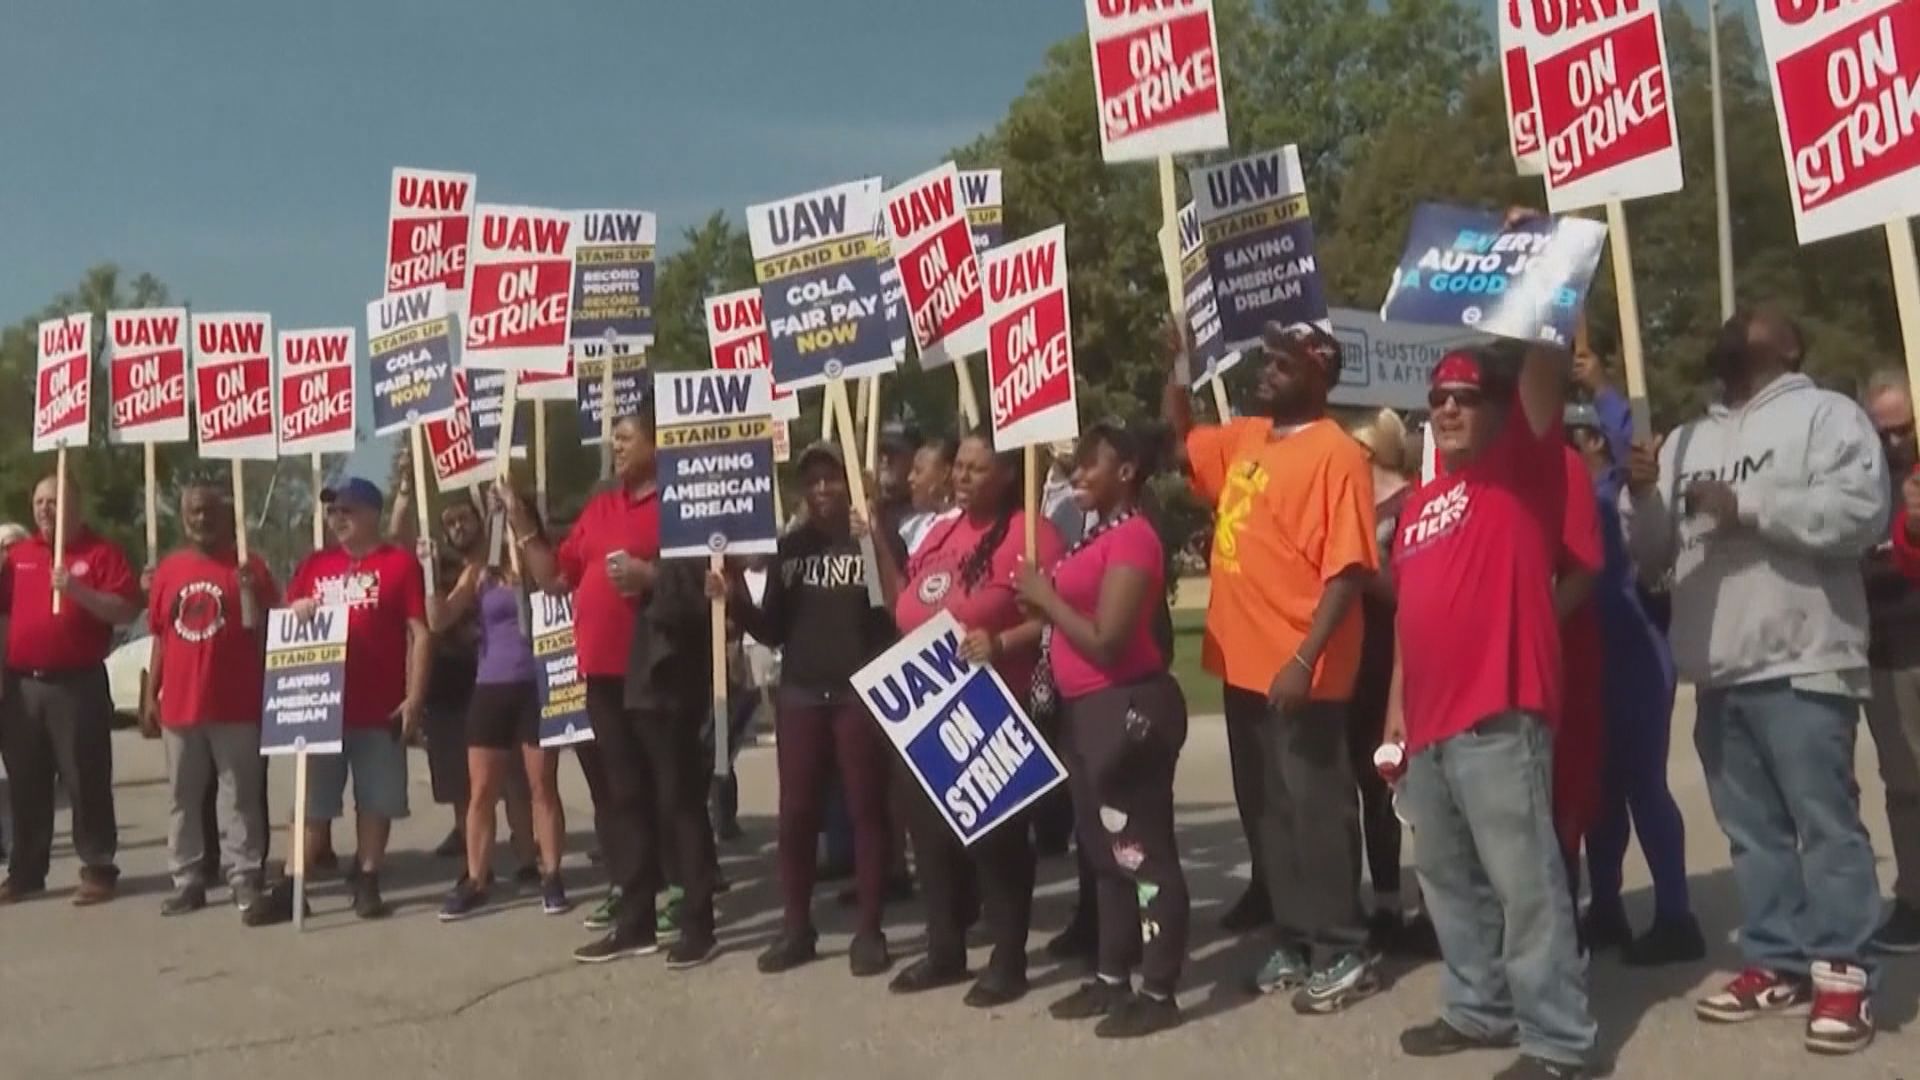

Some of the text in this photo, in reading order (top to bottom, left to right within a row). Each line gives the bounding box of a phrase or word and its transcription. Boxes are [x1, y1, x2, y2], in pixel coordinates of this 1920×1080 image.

[1129, 22, 1174, 80] ON
[1827, 15, 1898, 109] ON
[1568, 38, 1616, 107] ON
[1104, 47, 1215, 140] STRIKE
[1548, 64, 1665, 183] STRIKE
[1796, 73, 1920, 206] STRIK
[399, 175, 468, 211] UAW
[1207, 154, 1279, 209] UAW
[768, 193, 847, 246] UAW
[889, 176, 955, 237] UAW
[1207, 213, 1268, 241] STAND
[1273, 201, 1300, 219] UP
[410, 219, 443, 254] ON
[482, 214, 570, 255] UAW
[584, 213, 642, 242] UAW
[389, 243, 467, 289] STRIKE
[763, 244, 833, 277] STAND
[838, 239, 867, 258] UP
[920, 236, 949, 290] ON
[1223, 234, 1295, 270] SAVING
[1417, 247, 1501, 273] AUTO
[498, 264, 539, 304] ON
[583, 269, 640, 281] RECORD
[786, 273, 856, 306] COLA
[986, 240, 1056, 304] UAW
[1217, 255, 1316, 298] AMERICAN
[1401, 268, 1508, 294] A GOOD
[380, 290, 431, 330] UAW
[914, 254, 981, 347] STRIKE
[1235, 280, 1301, 312] DREAM
[115, 316, 178, 347] UAW
[467, 292, 568, 347] STRIKE
[770, 295, 878, 339] FAIR PAY
[44, 321, 85, 357] UAW
[199, 322, 264, 353] UAW
[285, 336, 348, 365] UAW
[373, 322, 444, 353] STAND UP
[734, 335, 763, 370] ON
[795, 323, 859, 353] NOW
[1007, 306, 1037, 367] ON
[49, 361, 71, 397] ON
[129, 355, 161, 389] ON
[386, 347, 432, 374] COLA
[992, 330, 1067, 425] STRIKE
[216, 364, 245, 401] ON
[300, 371, 329, 405] ON
[374, 363, 448, 397] FAIR PAY
[390, 382, 432, 408] NOW
[674, 374, 752, 416] UAW
[38, 379, 87, 434] STRIKE
[113, 373, 184, 426] STRIKE
[201, 385, 270, 441] STRIKE
[282, 387, 351, 440] STRIKE
[663, 421, 765, 446] STAND UP
[435, 433, 476, 477] STRI
[677, 452, 754, 476] SAVING
[662, 476, 770, 502] AMERICAN
[680, 497, 753, 520] DREAM
[280, 609, 334, 643] UAW
[271, 649, 341, 666] STAND UP
[867, 629, 970, 723] UAW
[277, 671, 331, 690] SAVING
[266, 691, 342, 712] AMERICAN
[938, 700, 985, 763] ON
[944, 714, 1035, 828] STRIKE
